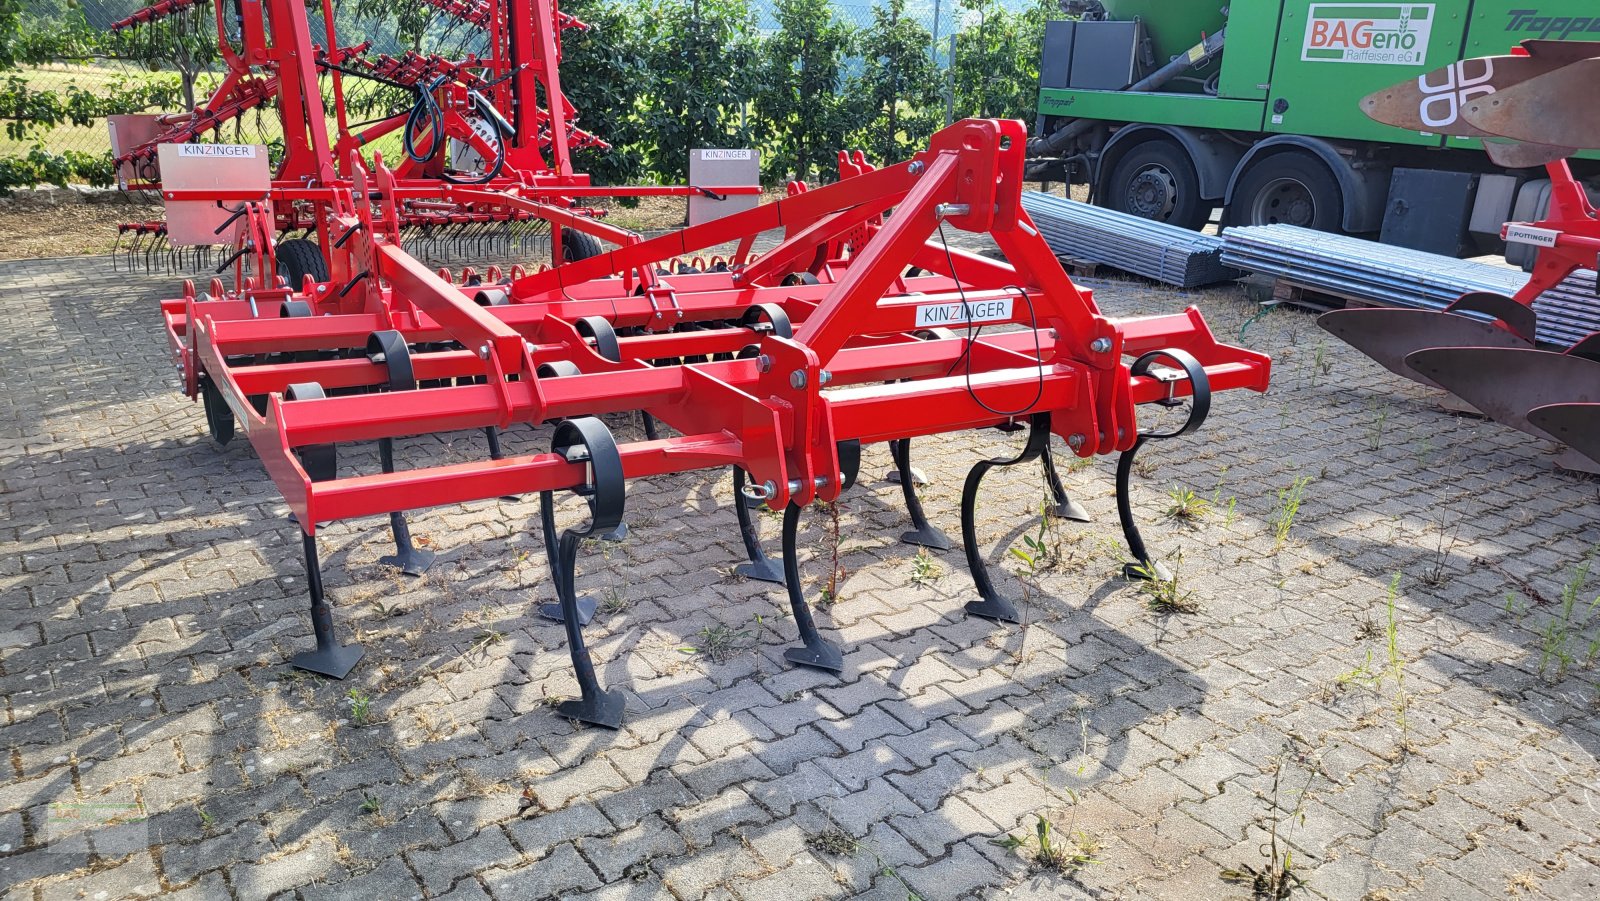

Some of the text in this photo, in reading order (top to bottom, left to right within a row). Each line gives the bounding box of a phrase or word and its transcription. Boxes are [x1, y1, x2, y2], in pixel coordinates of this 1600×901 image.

[1310, 20, 1416, 50] BAGeno
[1346, 49, 1413, 62] Raiffeisen eG
[184, 145, 250, 156] KINZINGER
[705, 150, 747, 158] KINZINGER
[924, 301, 1005, 323] KINZINGER
